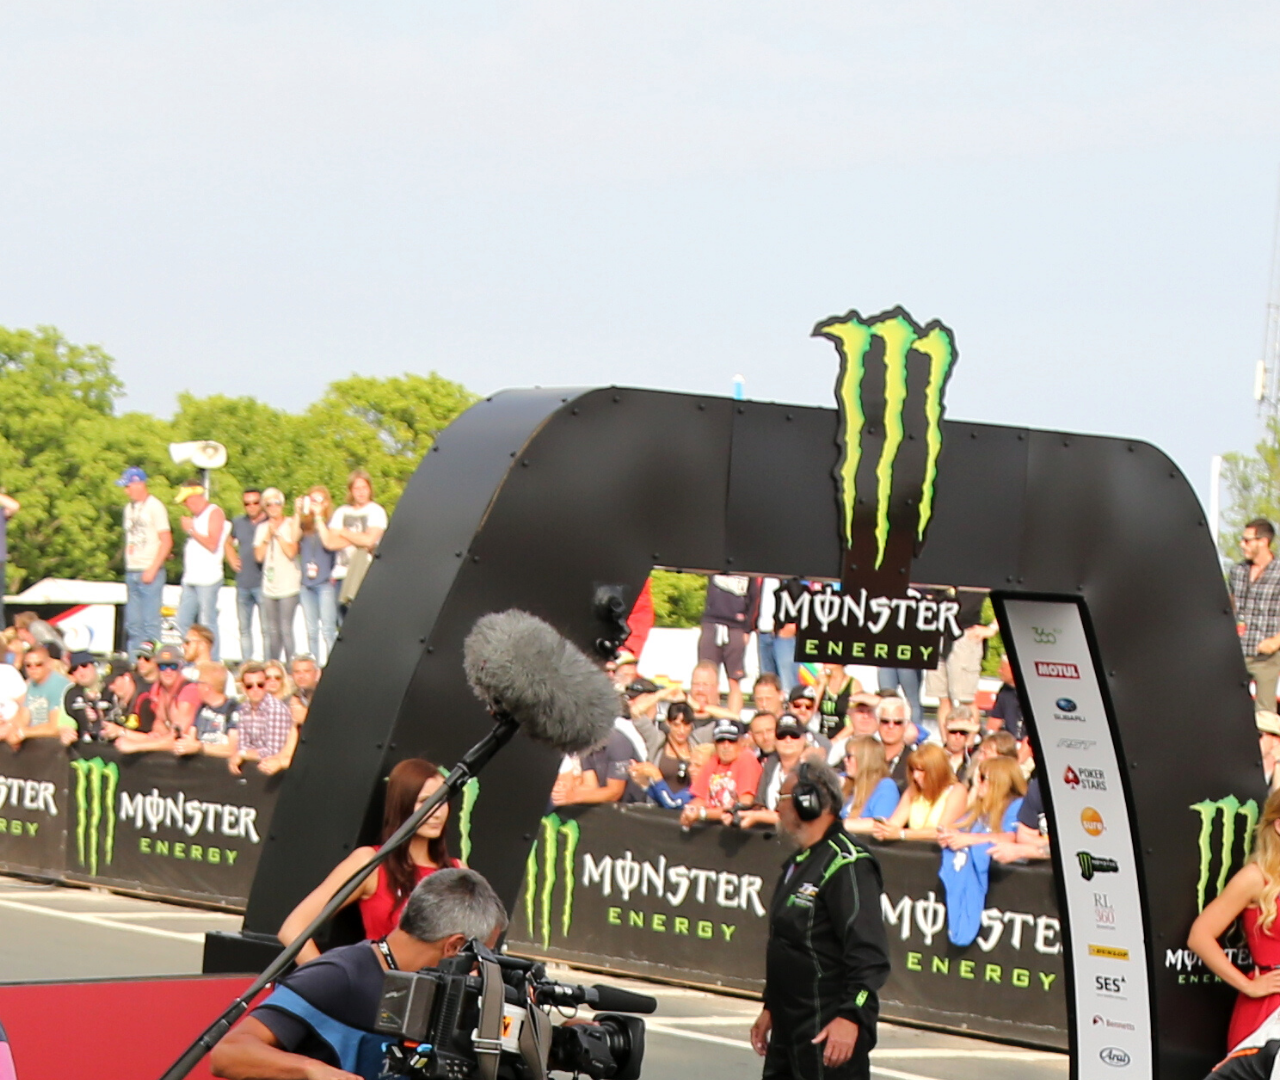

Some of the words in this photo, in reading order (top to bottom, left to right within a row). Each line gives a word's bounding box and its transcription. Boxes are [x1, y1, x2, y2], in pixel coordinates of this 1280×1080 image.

[805, 639, 933, 661] ENERGY
[1037, 662, 1079, 679] MOTUL
[1053, 713, 1087, 722] SUBARU
[1078, 767, 1105, 780] POKER
[1081, 778, 1107, 791] STARS
[1082, 820, 1103, 830] sure
[140, 837, 238, 866] ENERGY
[1093, 892, 1114, 909] RL
[607, 906, 737, 942] ENERGY
[880, 890, 1062, 954] MOSTE
[1095, 908, 1115, 925] 360
[1096, 949, 1129, 958] DUNLOP
[906, 951, 1057, 991] ENERGY
[1095, 975, 1121, 993] SES
